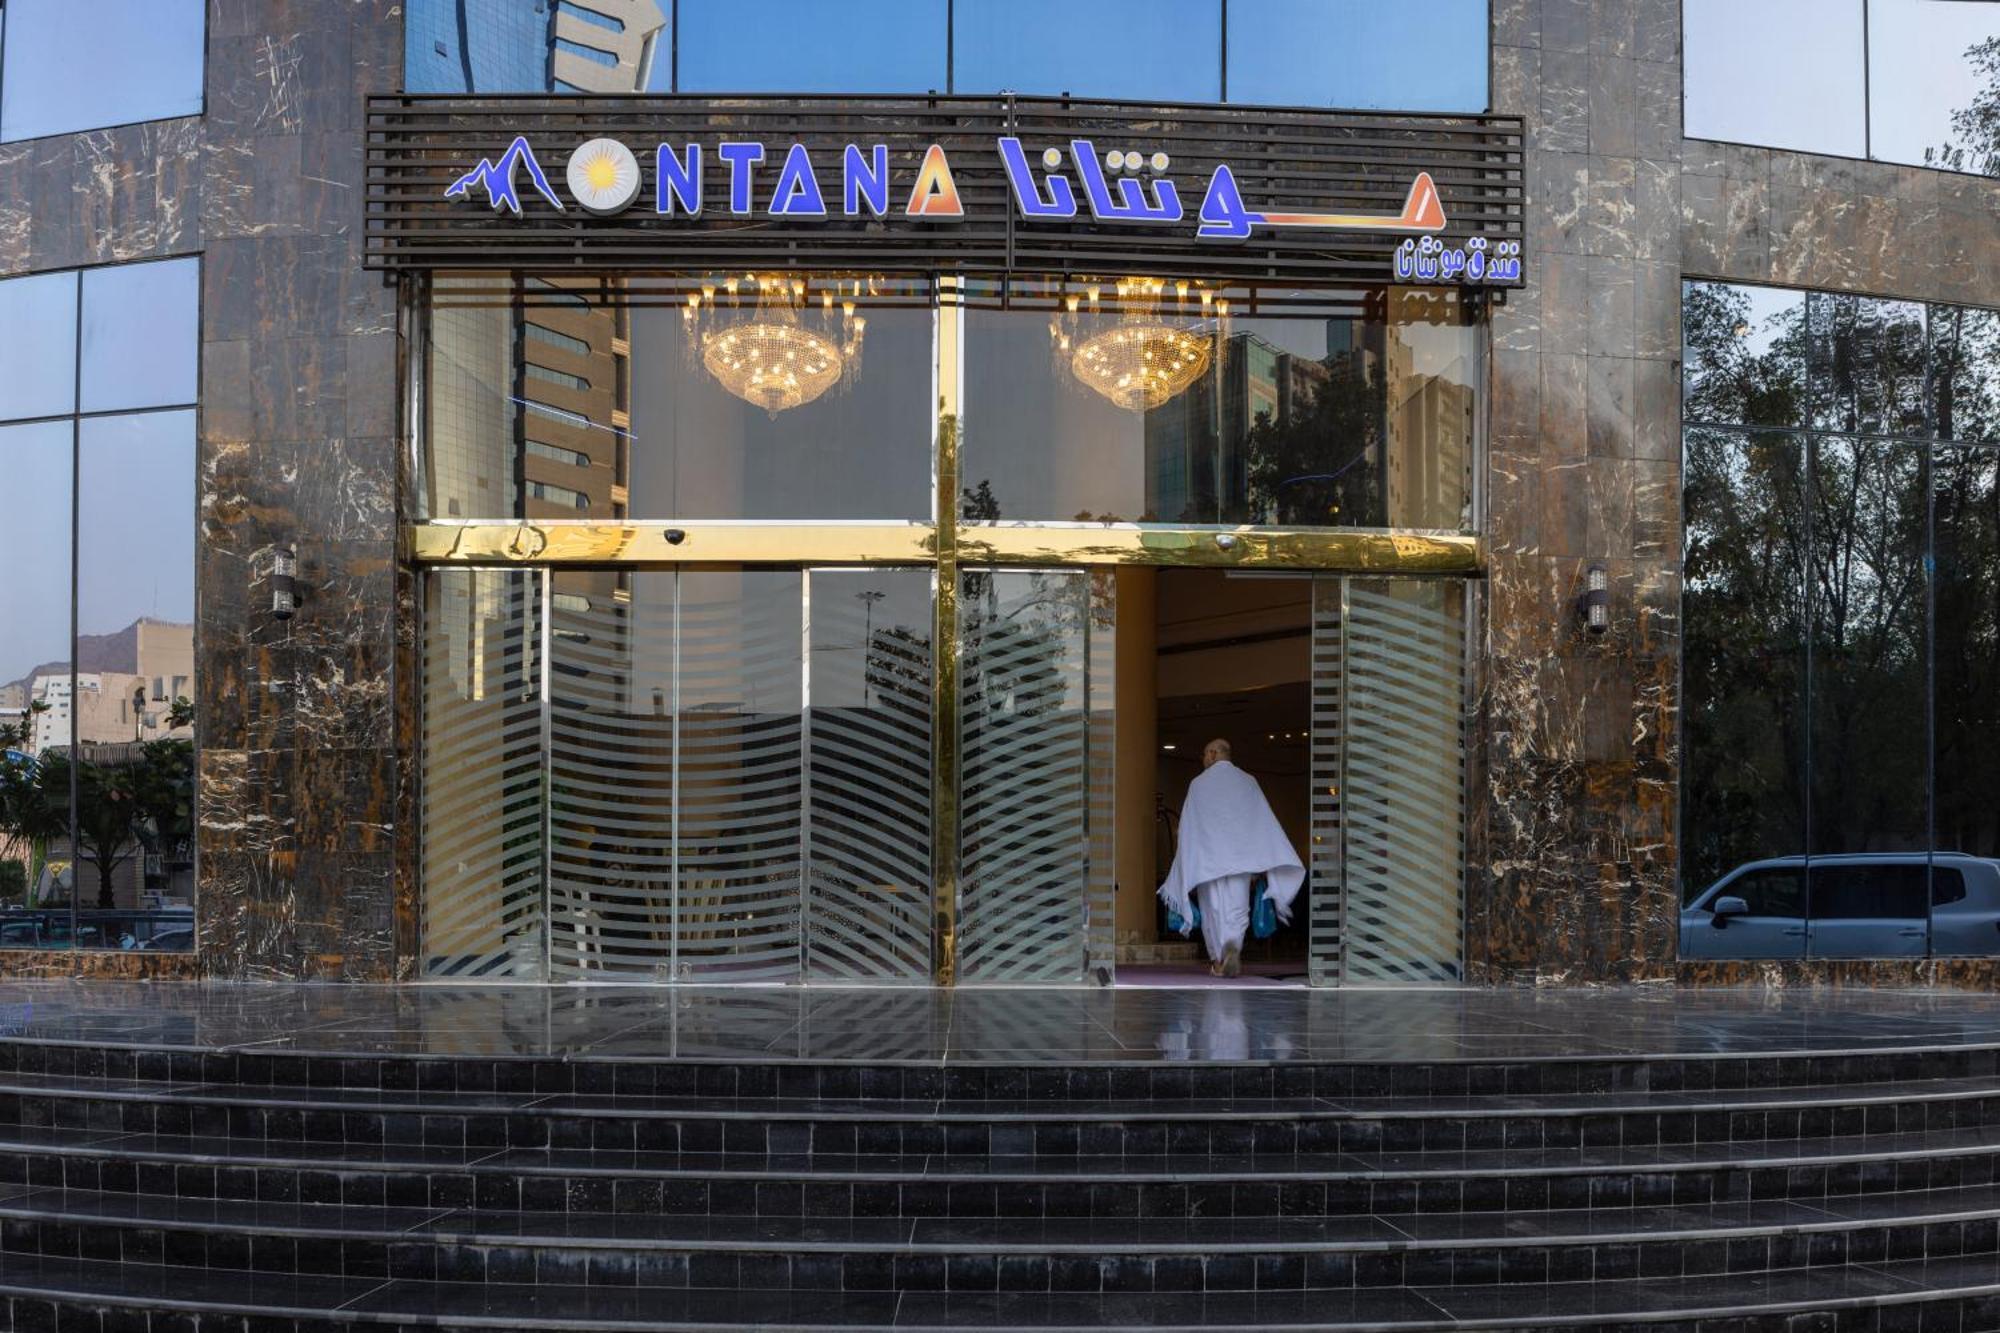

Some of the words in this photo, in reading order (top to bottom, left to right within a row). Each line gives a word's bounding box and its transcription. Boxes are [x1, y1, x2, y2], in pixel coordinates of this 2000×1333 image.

[998, 137, 1446, 240] مونتانا
[1397, 236, 1465, 279] مونتانا
[1467, 237, 1520, 280] فندق
